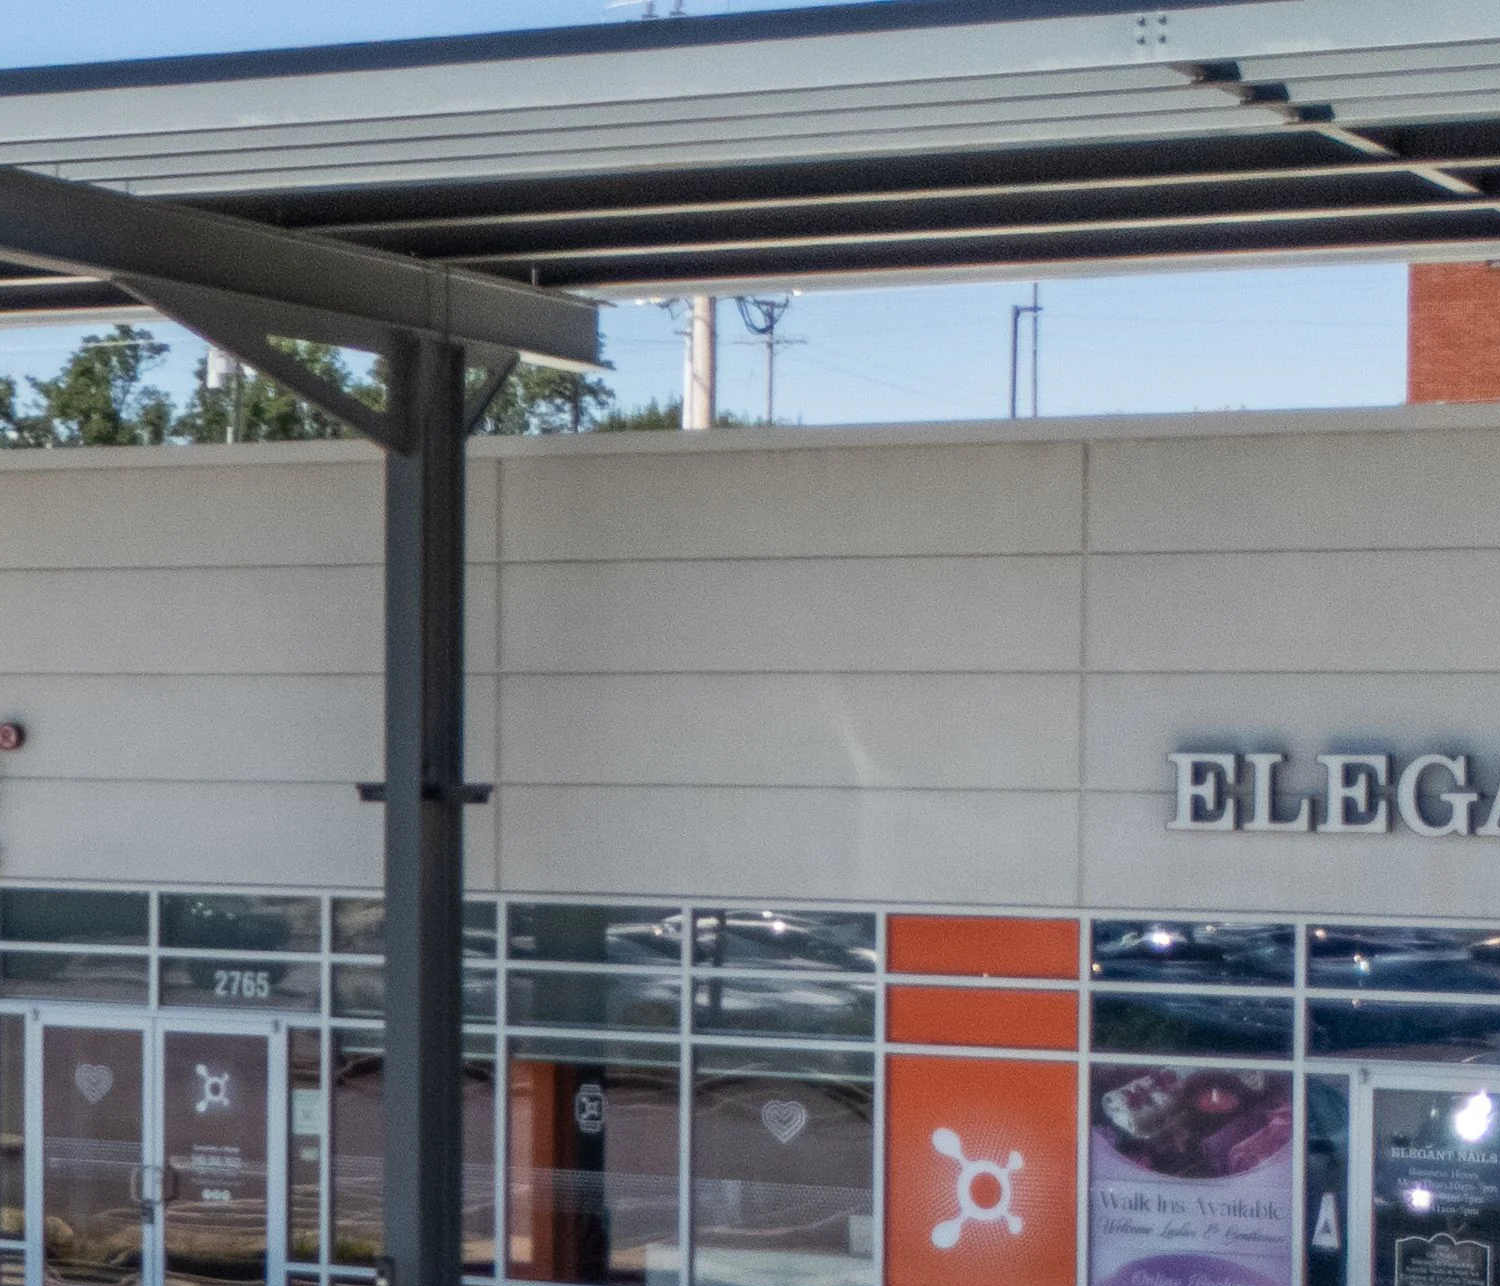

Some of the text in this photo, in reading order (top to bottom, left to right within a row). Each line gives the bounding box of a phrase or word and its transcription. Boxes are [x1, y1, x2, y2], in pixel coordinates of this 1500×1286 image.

[214, 970, 270, 998] 2765
[1392, 1147, 1498, 1164] ELEGANT NAILS
[1100, 1190, 1152, 1212] Walk
